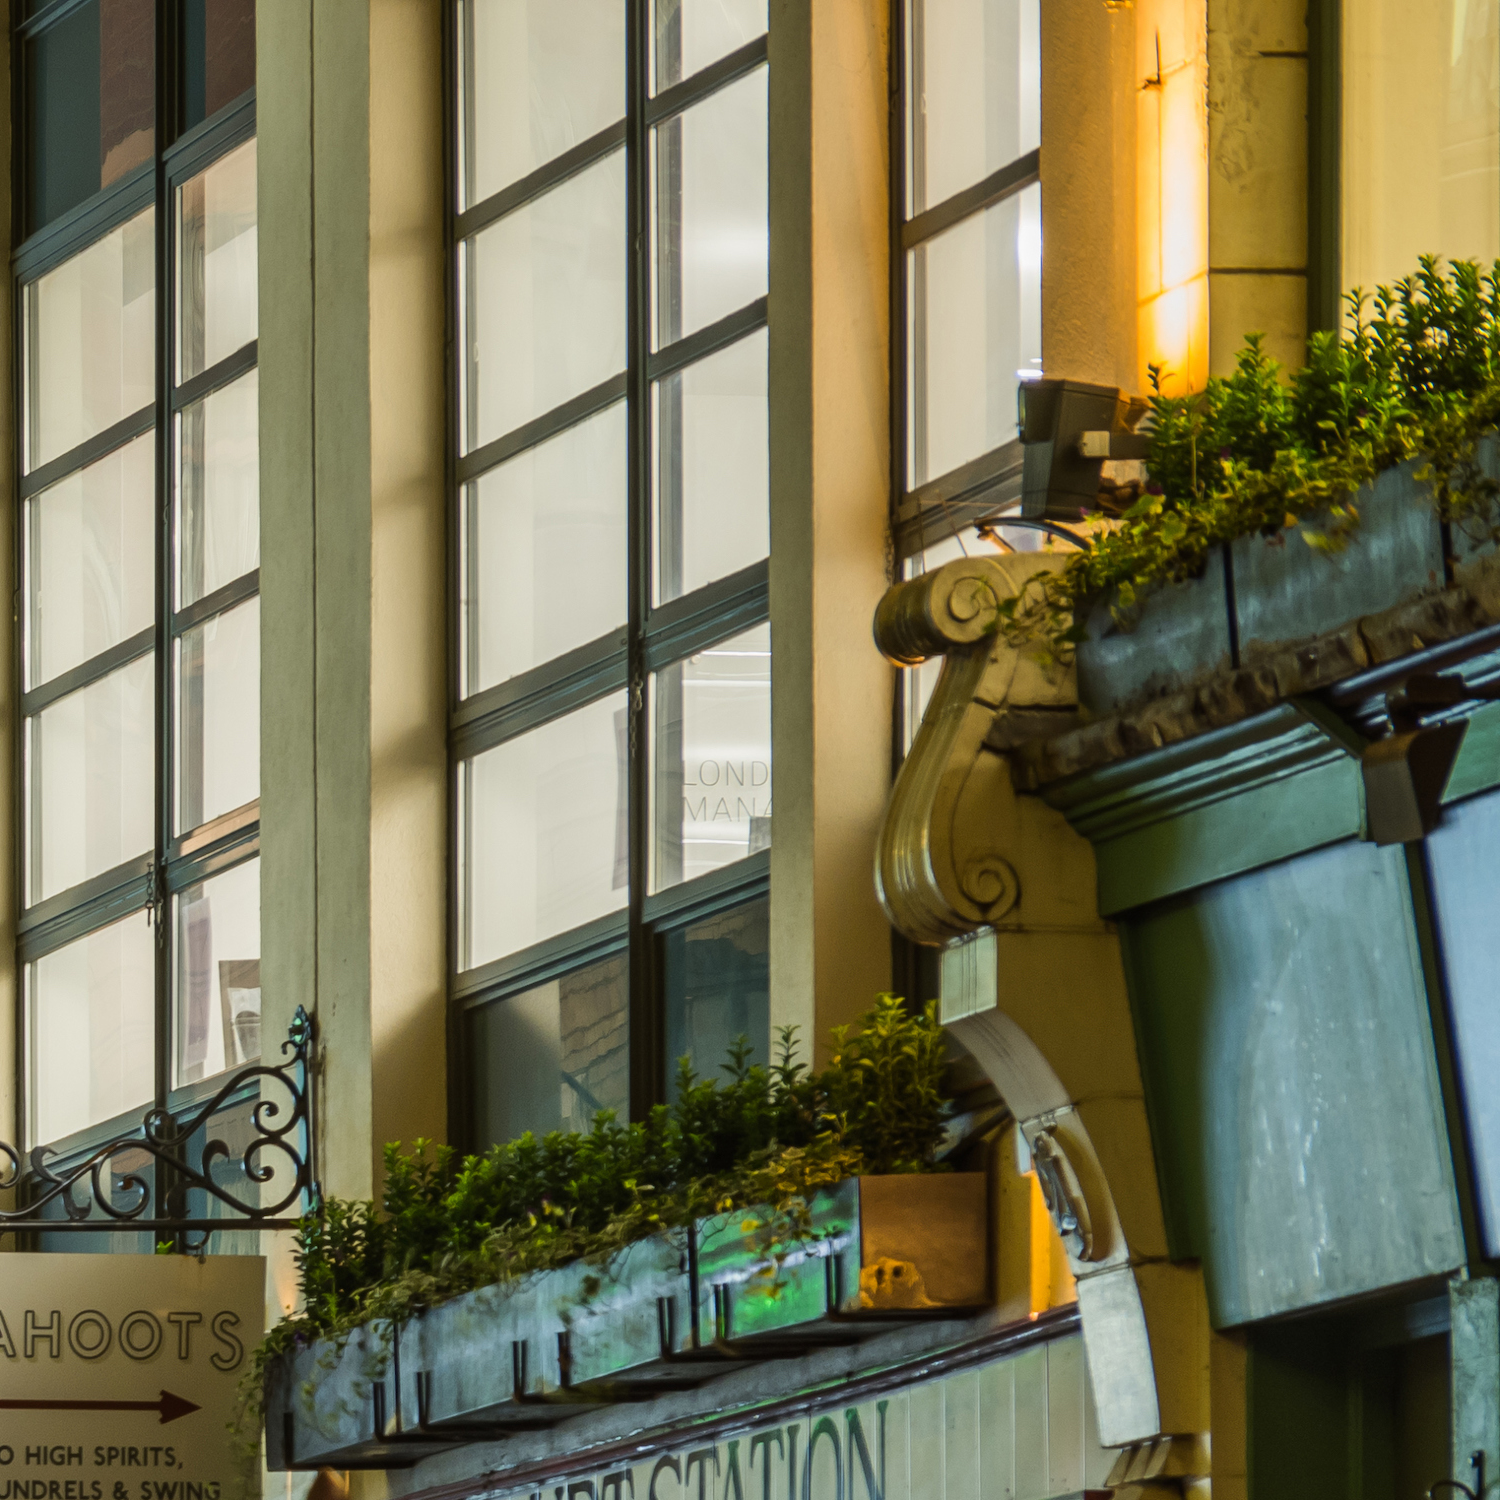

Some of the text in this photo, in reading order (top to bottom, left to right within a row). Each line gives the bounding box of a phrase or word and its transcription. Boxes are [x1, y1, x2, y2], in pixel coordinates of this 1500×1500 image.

[25, 1445, 84, 1467] HIGH
[93, 1446, 185, 1470] SPIRITS,
[112, 1481, 130, 1500] &
